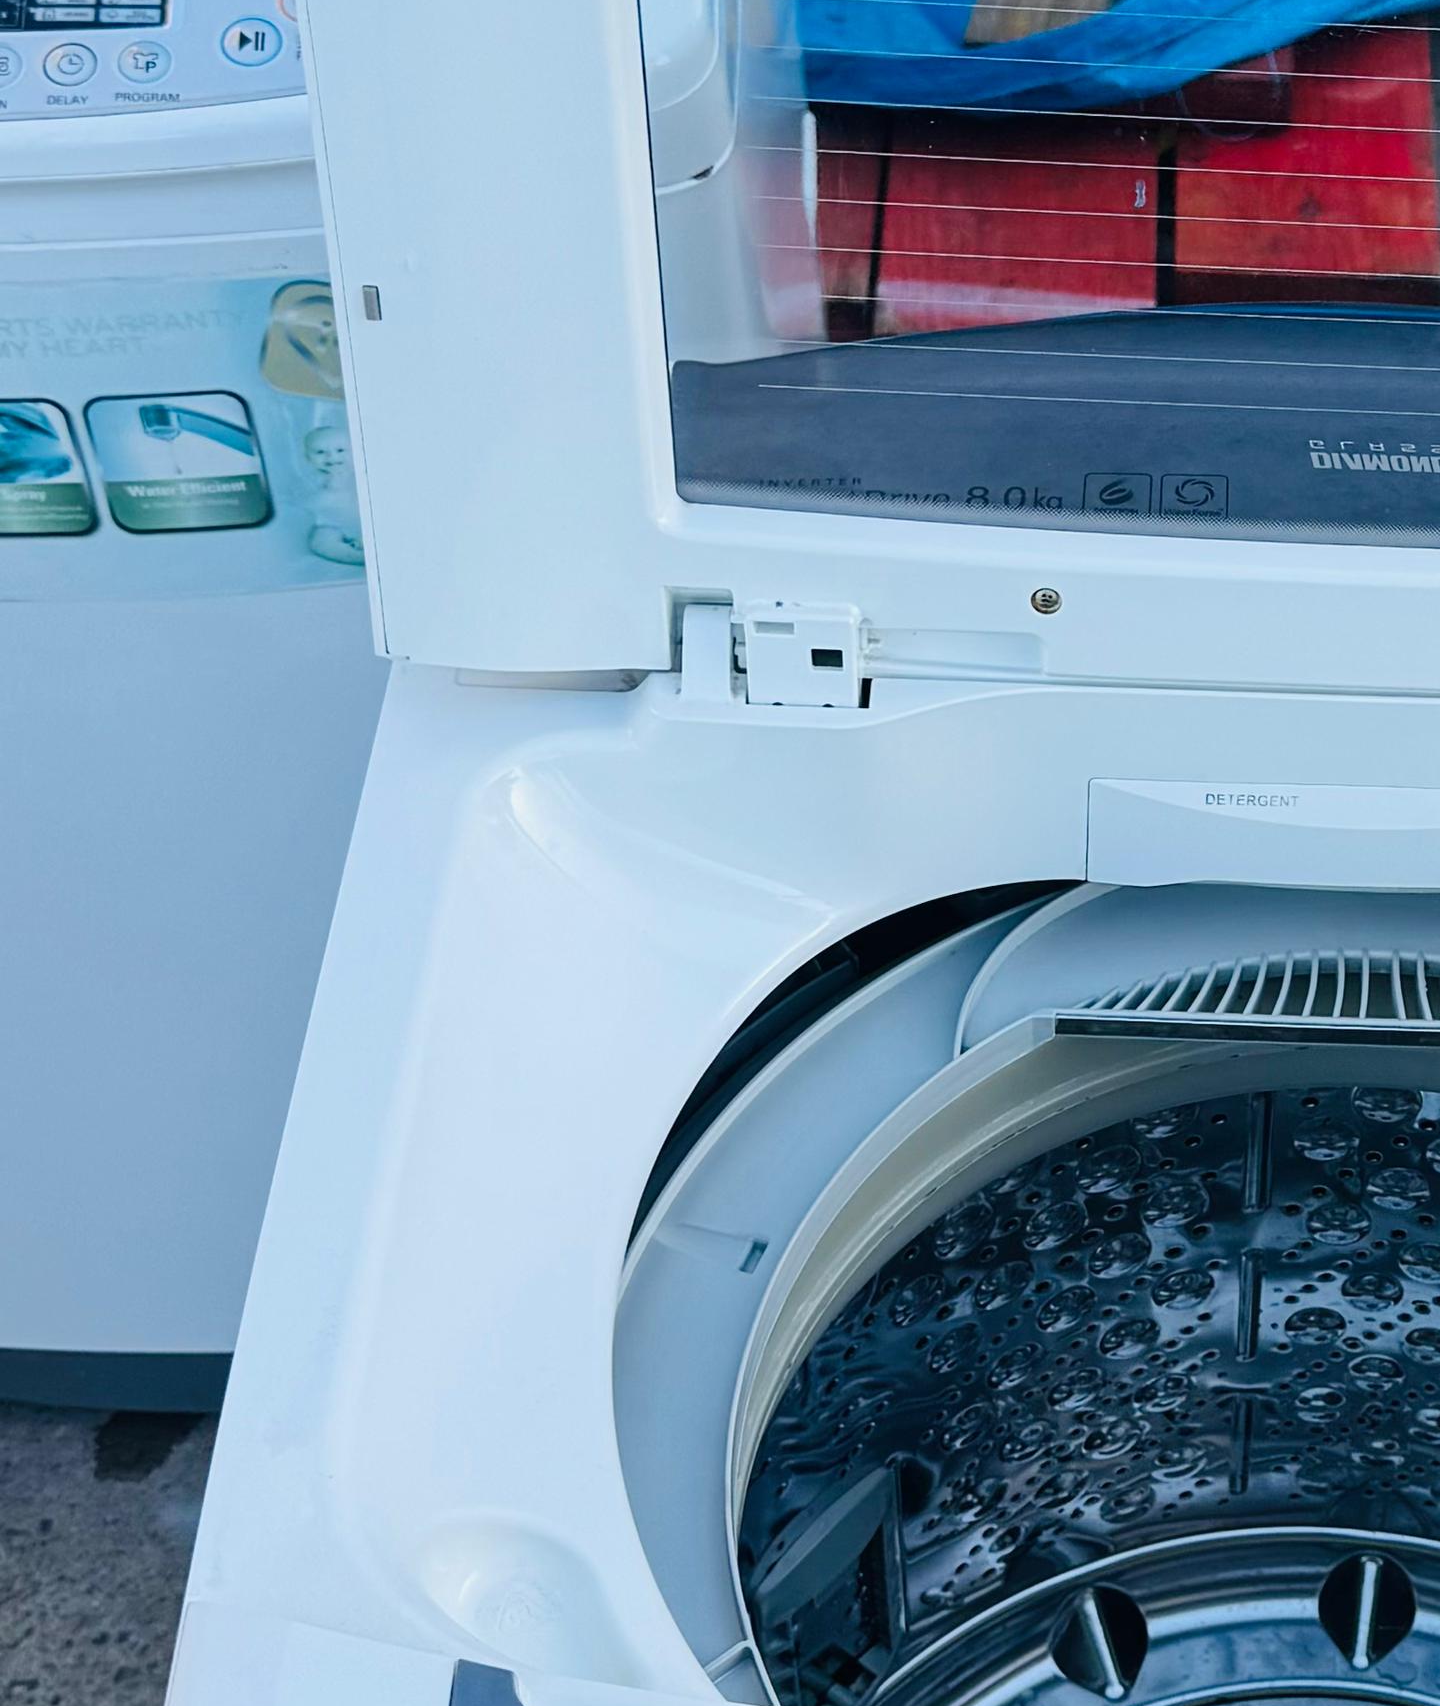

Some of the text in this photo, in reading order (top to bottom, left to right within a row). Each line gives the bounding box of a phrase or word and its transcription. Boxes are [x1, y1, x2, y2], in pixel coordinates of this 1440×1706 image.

[46, 92, 180, 106] DELAY PROGRAM
[1205, 793, 1299, 807] DETERGENT
